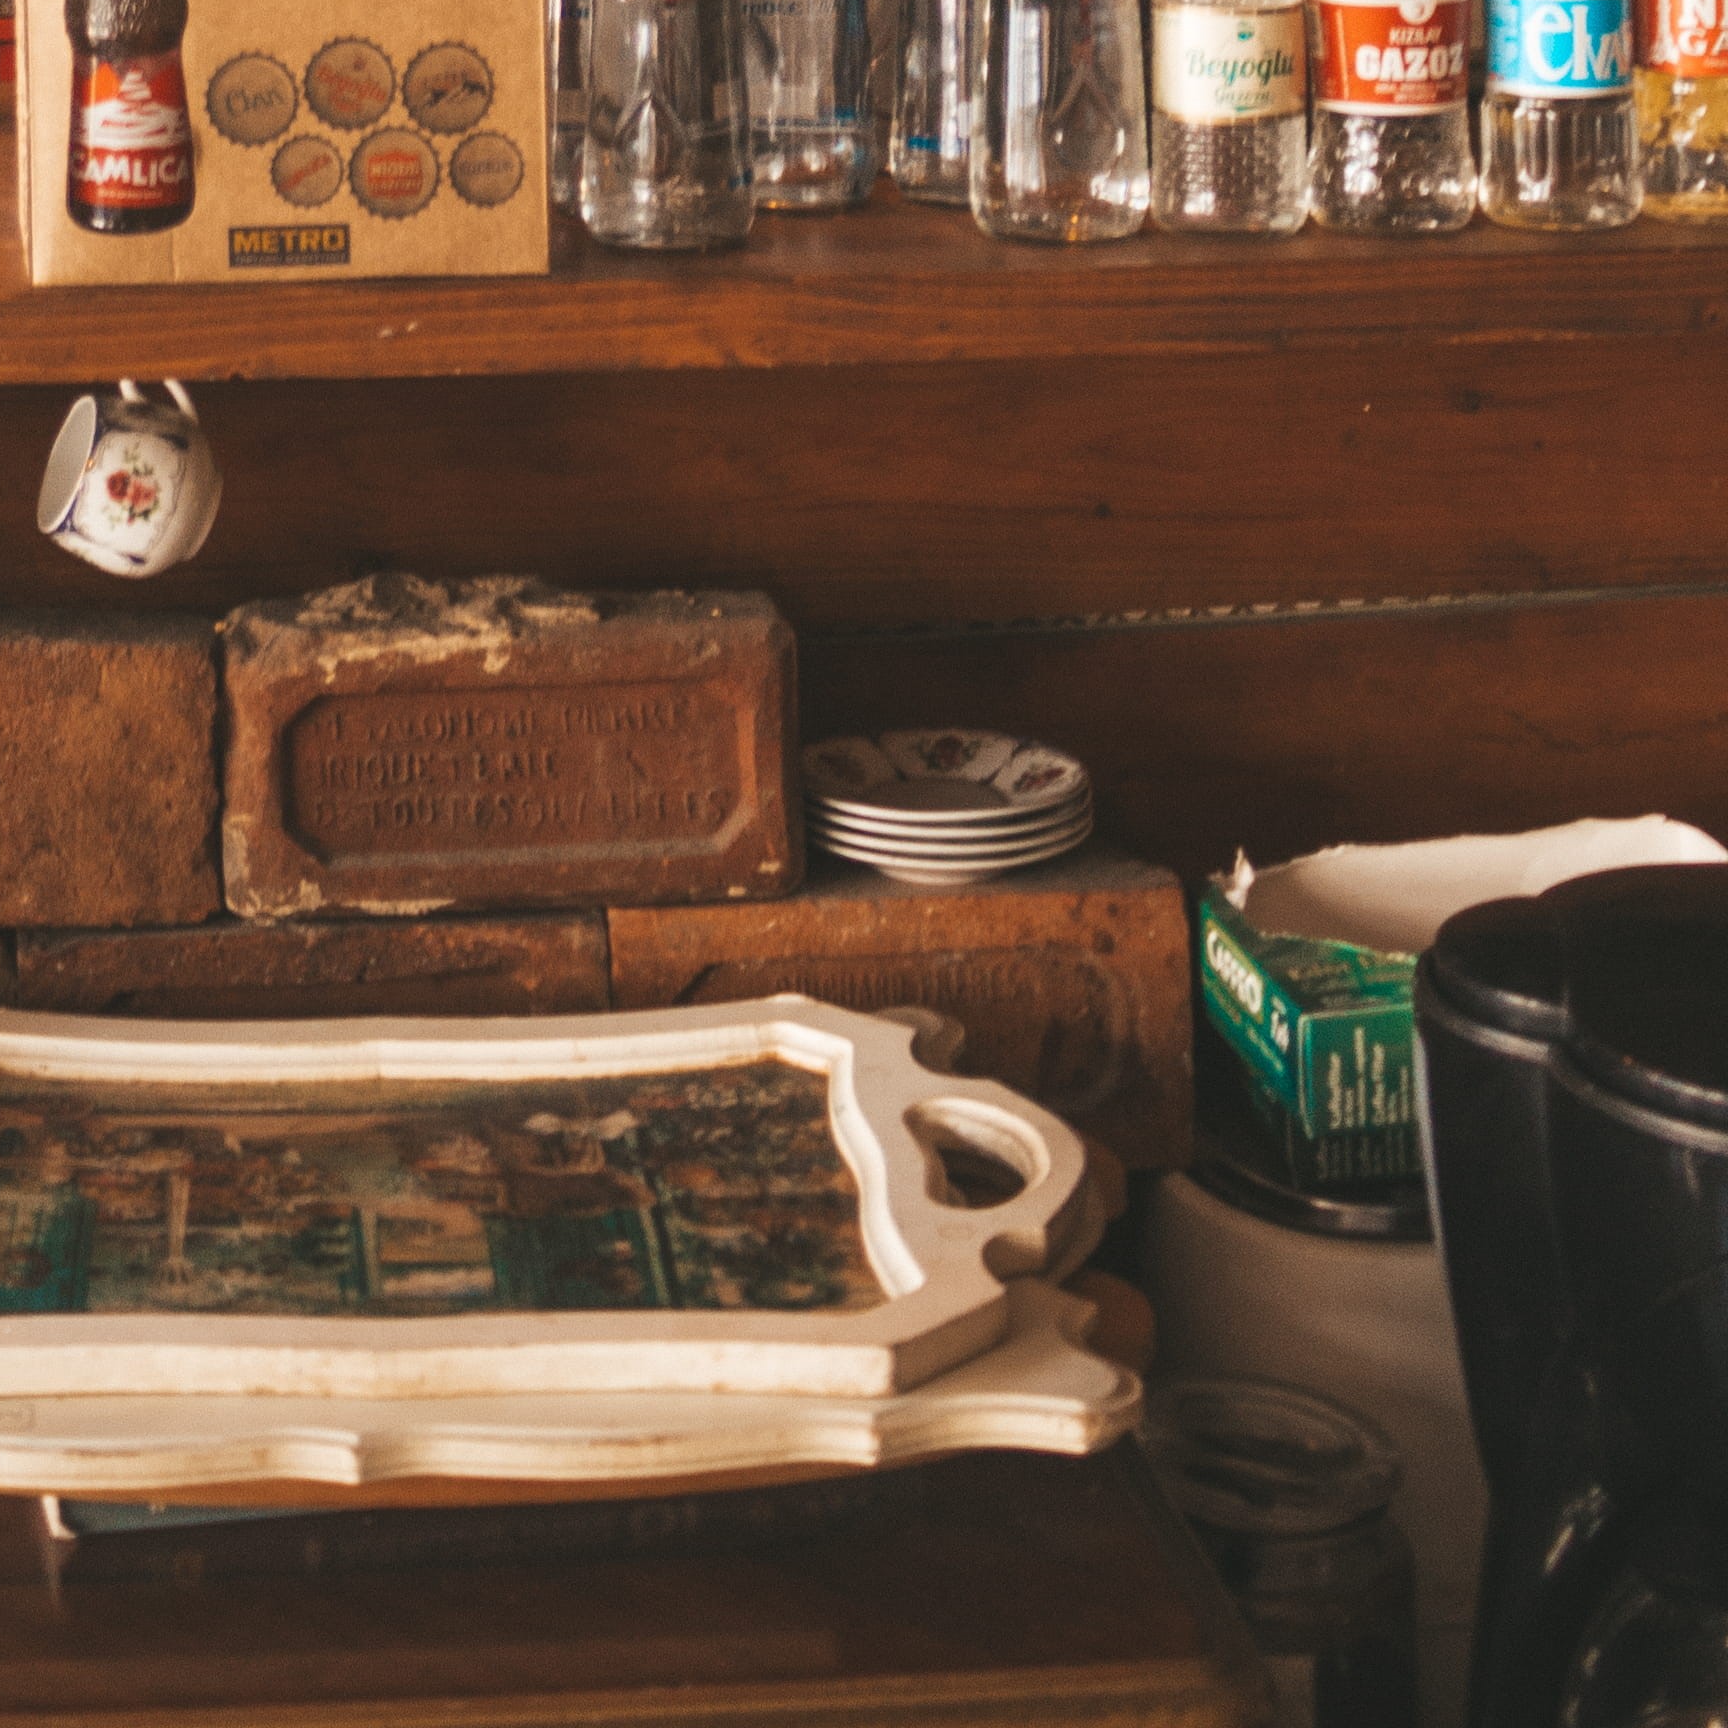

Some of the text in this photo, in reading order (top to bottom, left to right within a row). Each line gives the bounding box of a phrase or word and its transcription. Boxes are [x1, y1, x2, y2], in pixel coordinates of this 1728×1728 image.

[1186, 48, 1294, 86] Beyoğlu
[1355, 40, 1466, 82] GAZOZ
[234, 228, 345, 255] METRO
